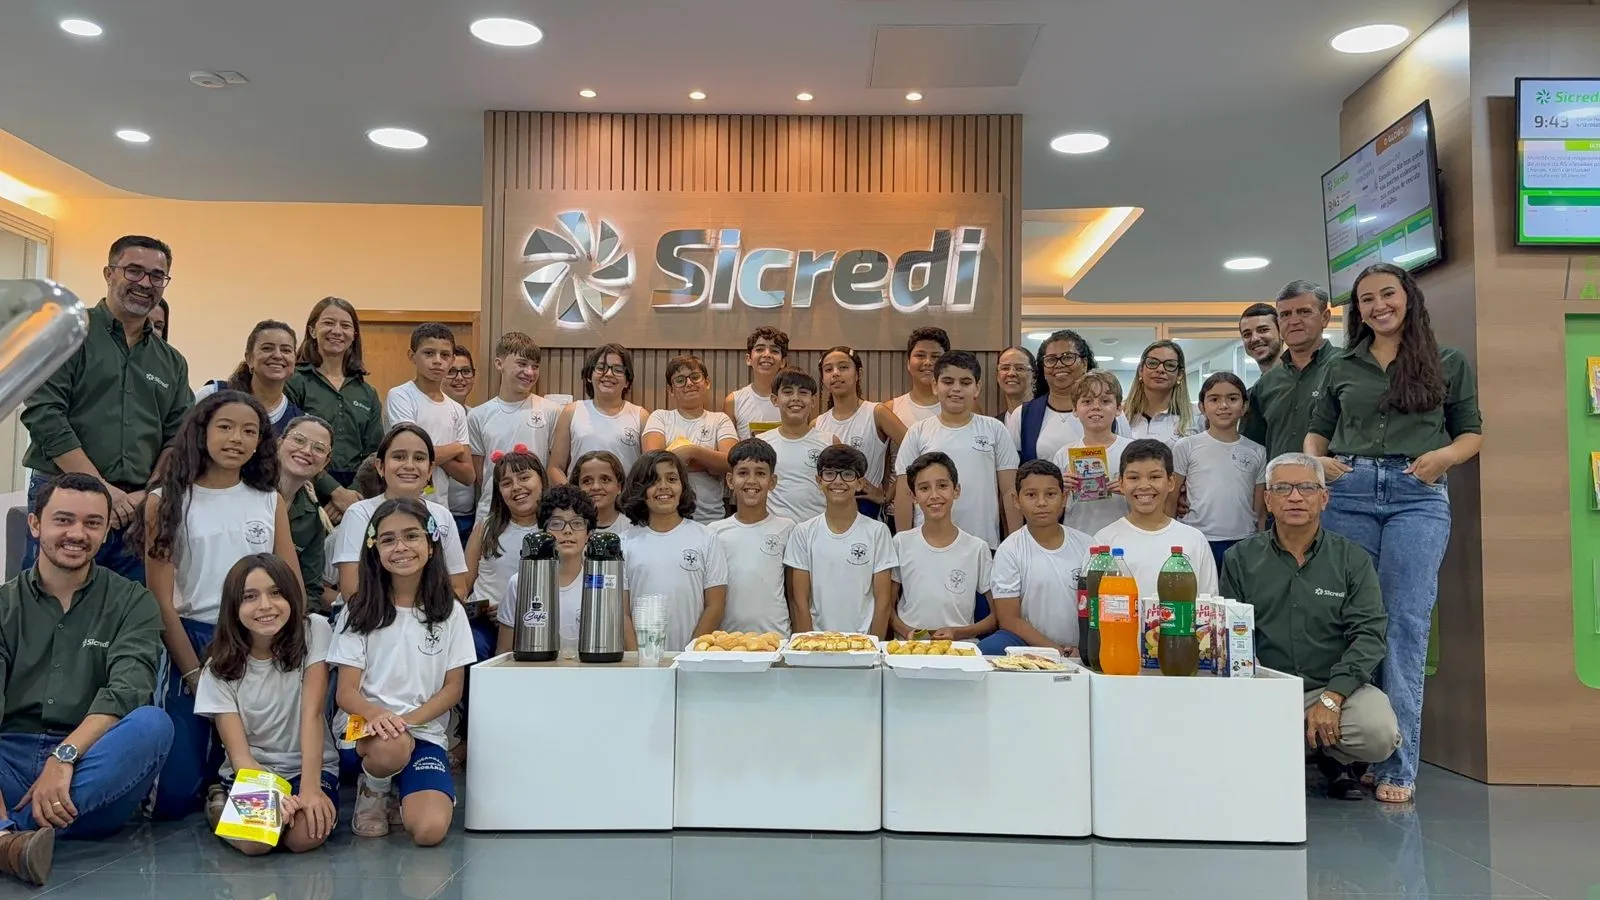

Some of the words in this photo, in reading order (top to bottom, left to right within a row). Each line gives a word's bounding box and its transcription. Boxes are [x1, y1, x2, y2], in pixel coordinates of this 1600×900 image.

[1555, 91, 1600, 103] Sicred
[1534, 115, 1569, 128] 9:43
[652, 226, 985, 313] Sicredi
[523, 611, 547, 622] Café
